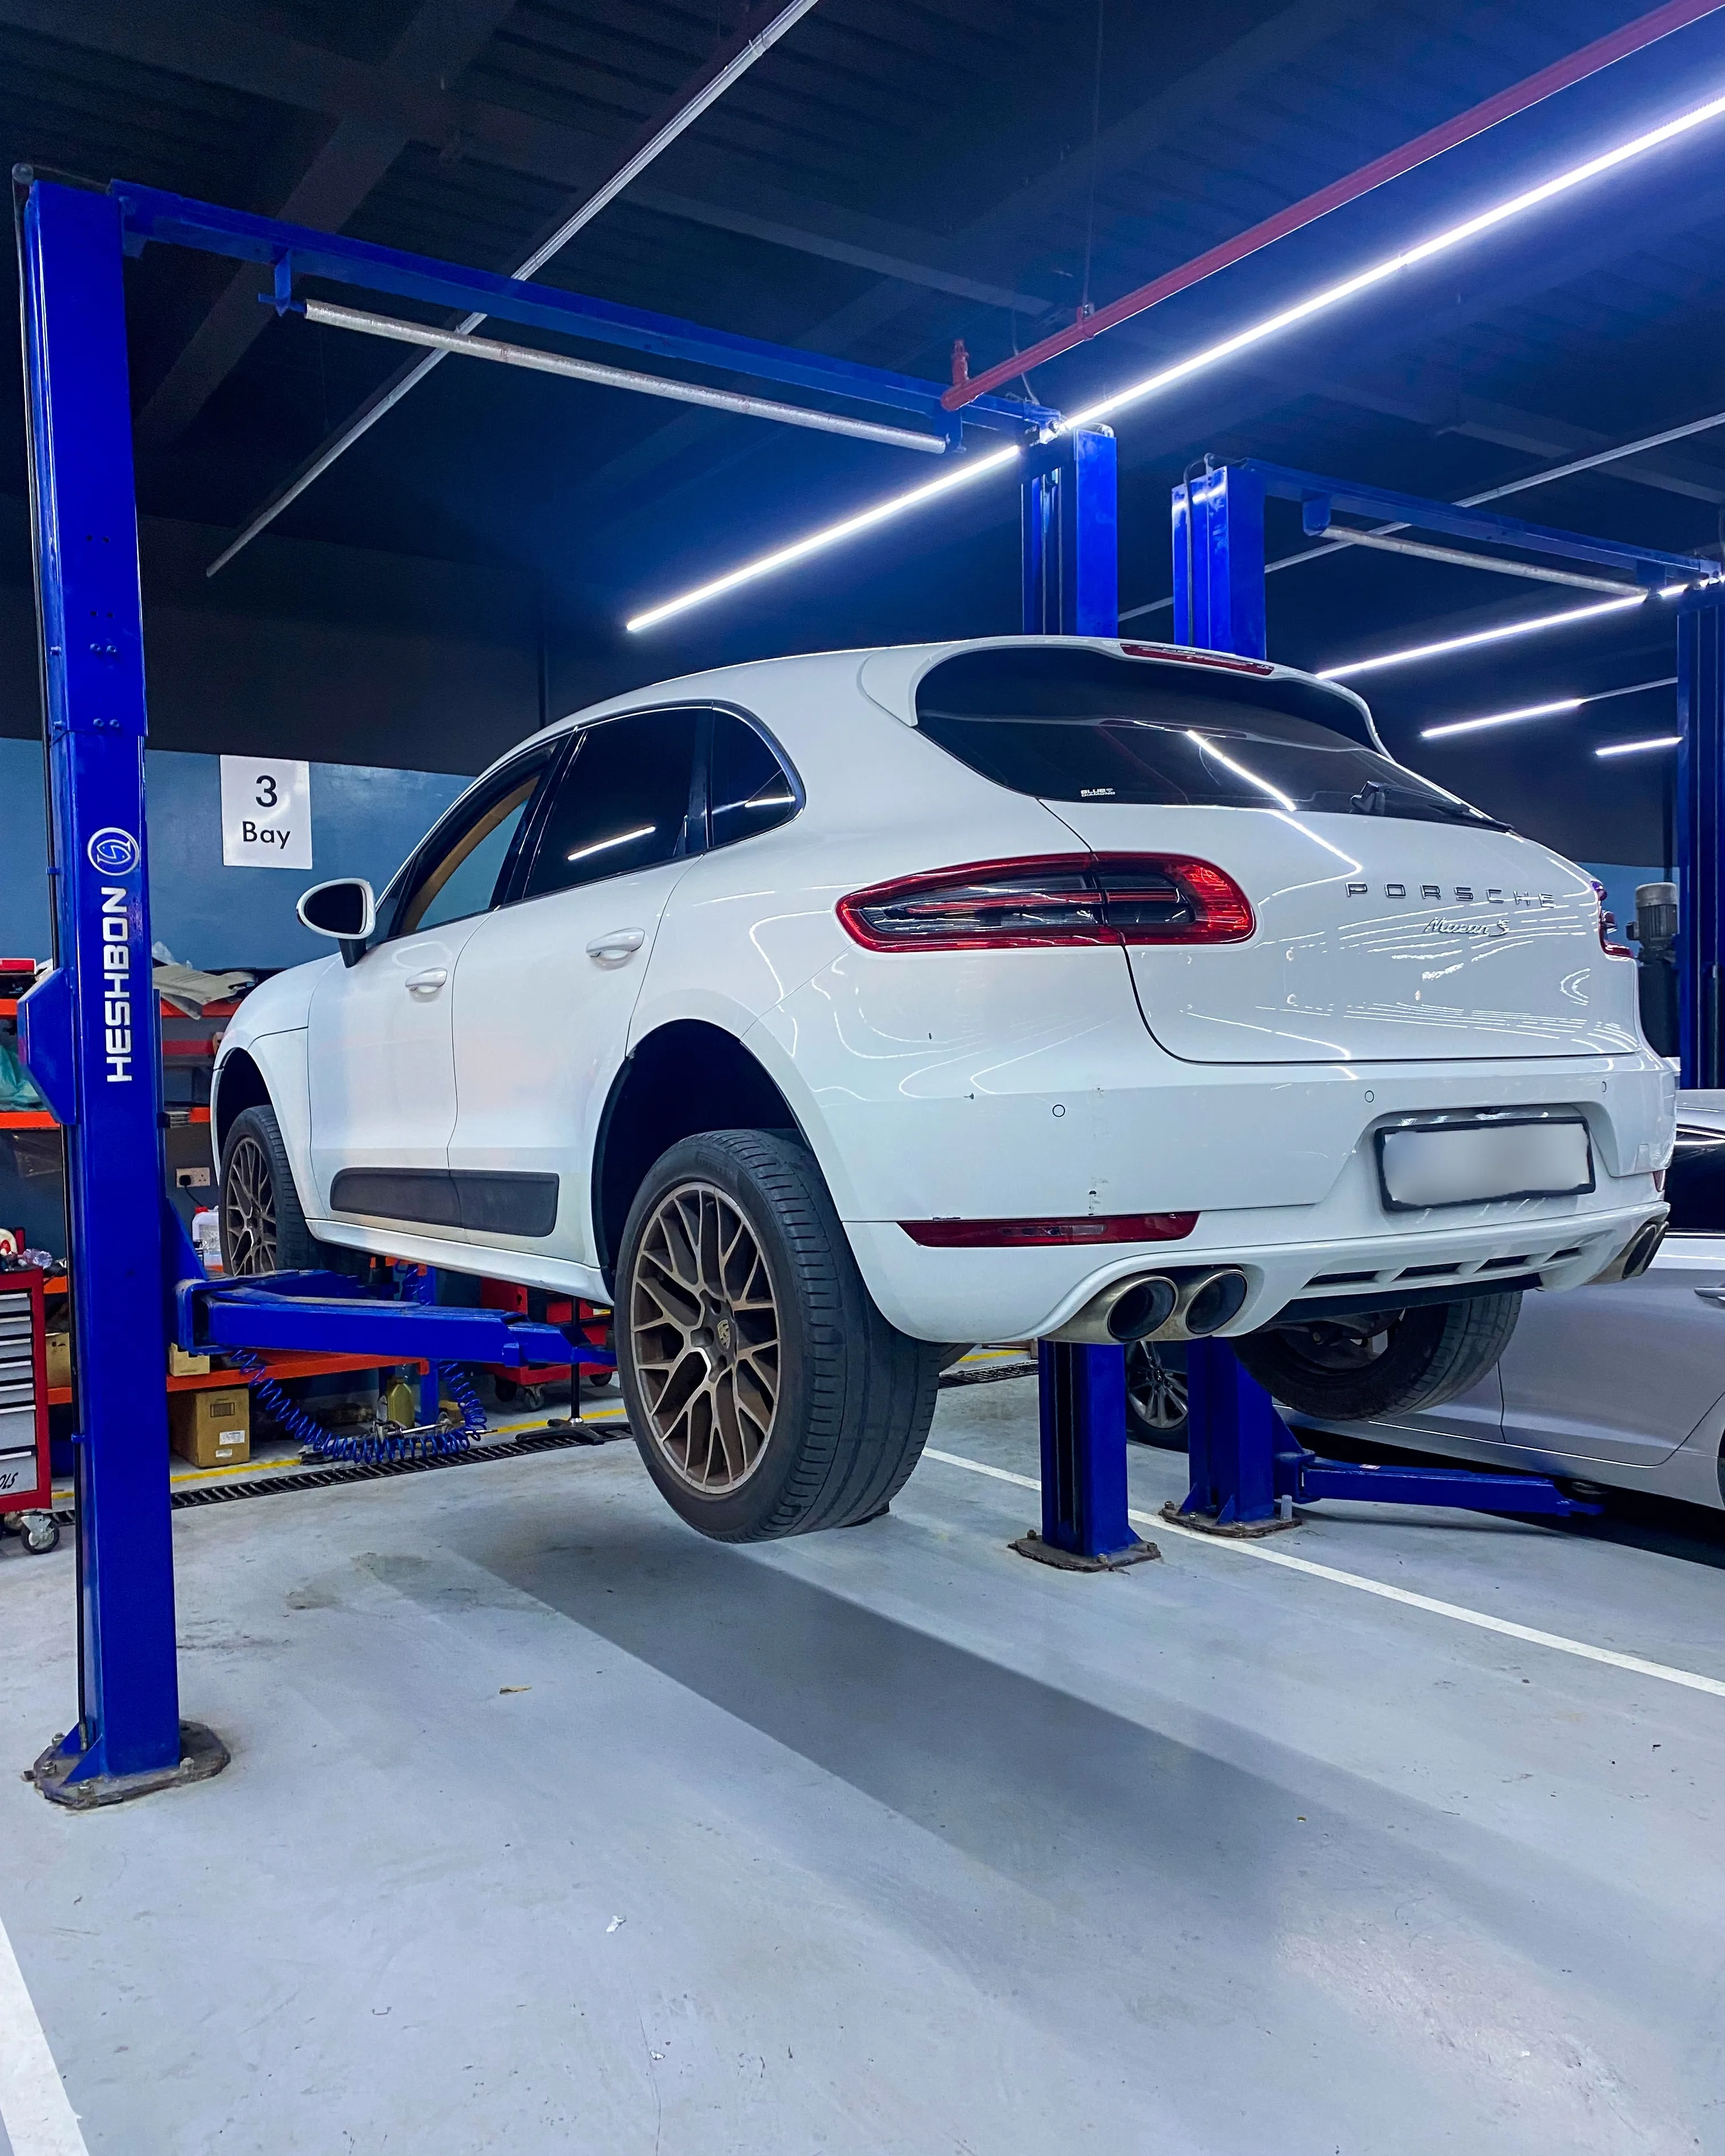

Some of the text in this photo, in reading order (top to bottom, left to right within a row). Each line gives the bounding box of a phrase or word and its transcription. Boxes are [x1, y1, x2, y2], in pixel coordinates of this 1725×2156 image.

[256, 775, 277, 808] 3
[242, 821, 291, 849] Bay
[1345, 882, 1556, 908] PORSCHE
[1423, 917, 1511, 937] Macan S
[101, 886, 133, 1083] HESHBON
